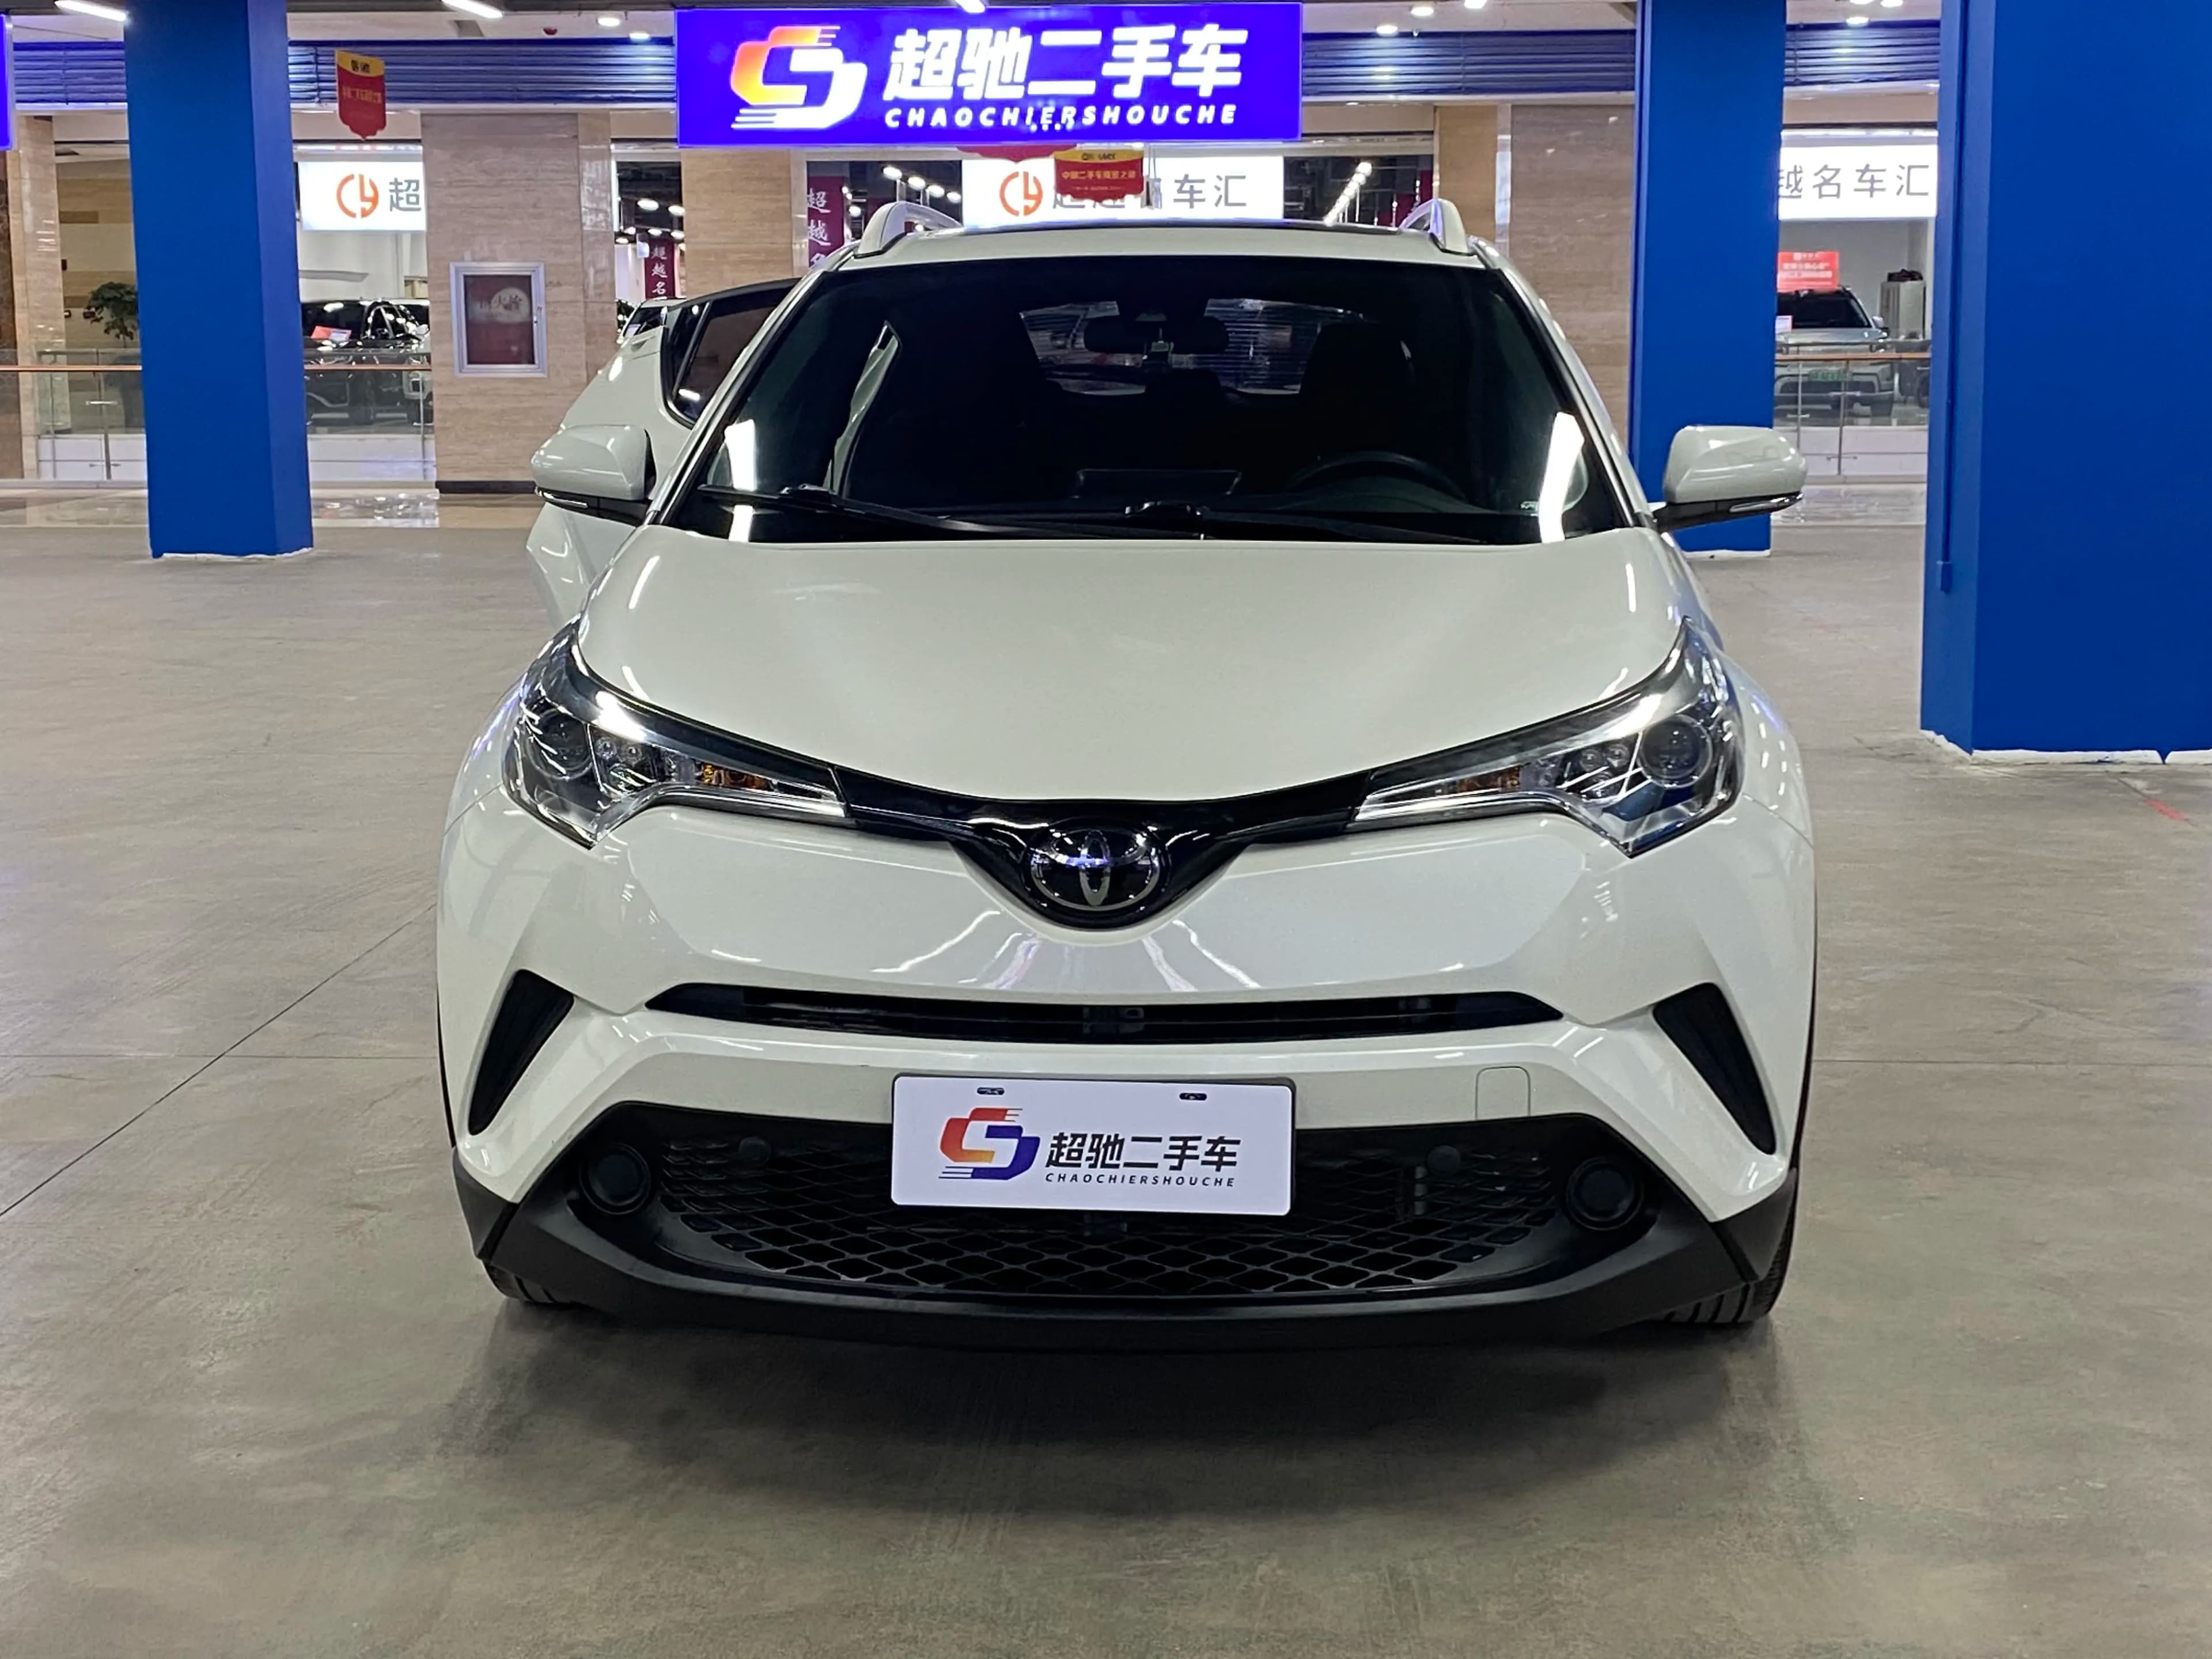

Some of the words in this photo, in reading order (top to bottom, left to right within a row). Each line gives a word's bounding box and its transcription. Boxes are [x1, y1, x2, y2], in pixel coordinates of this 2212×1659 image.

[882, 23, 1248, 100] 超驰二手车
[885, 104, 1237, 128] CHAOCHIERSHOUCHE
[388, 177, 422, 212] 超
[1776, 163, 1929, 199] 越名车汇
[1045, 1132, 1241, 1172] 超驰二手车
[1046, 1173, 1234, 1187] CHAOCHIERSHOUCHE
